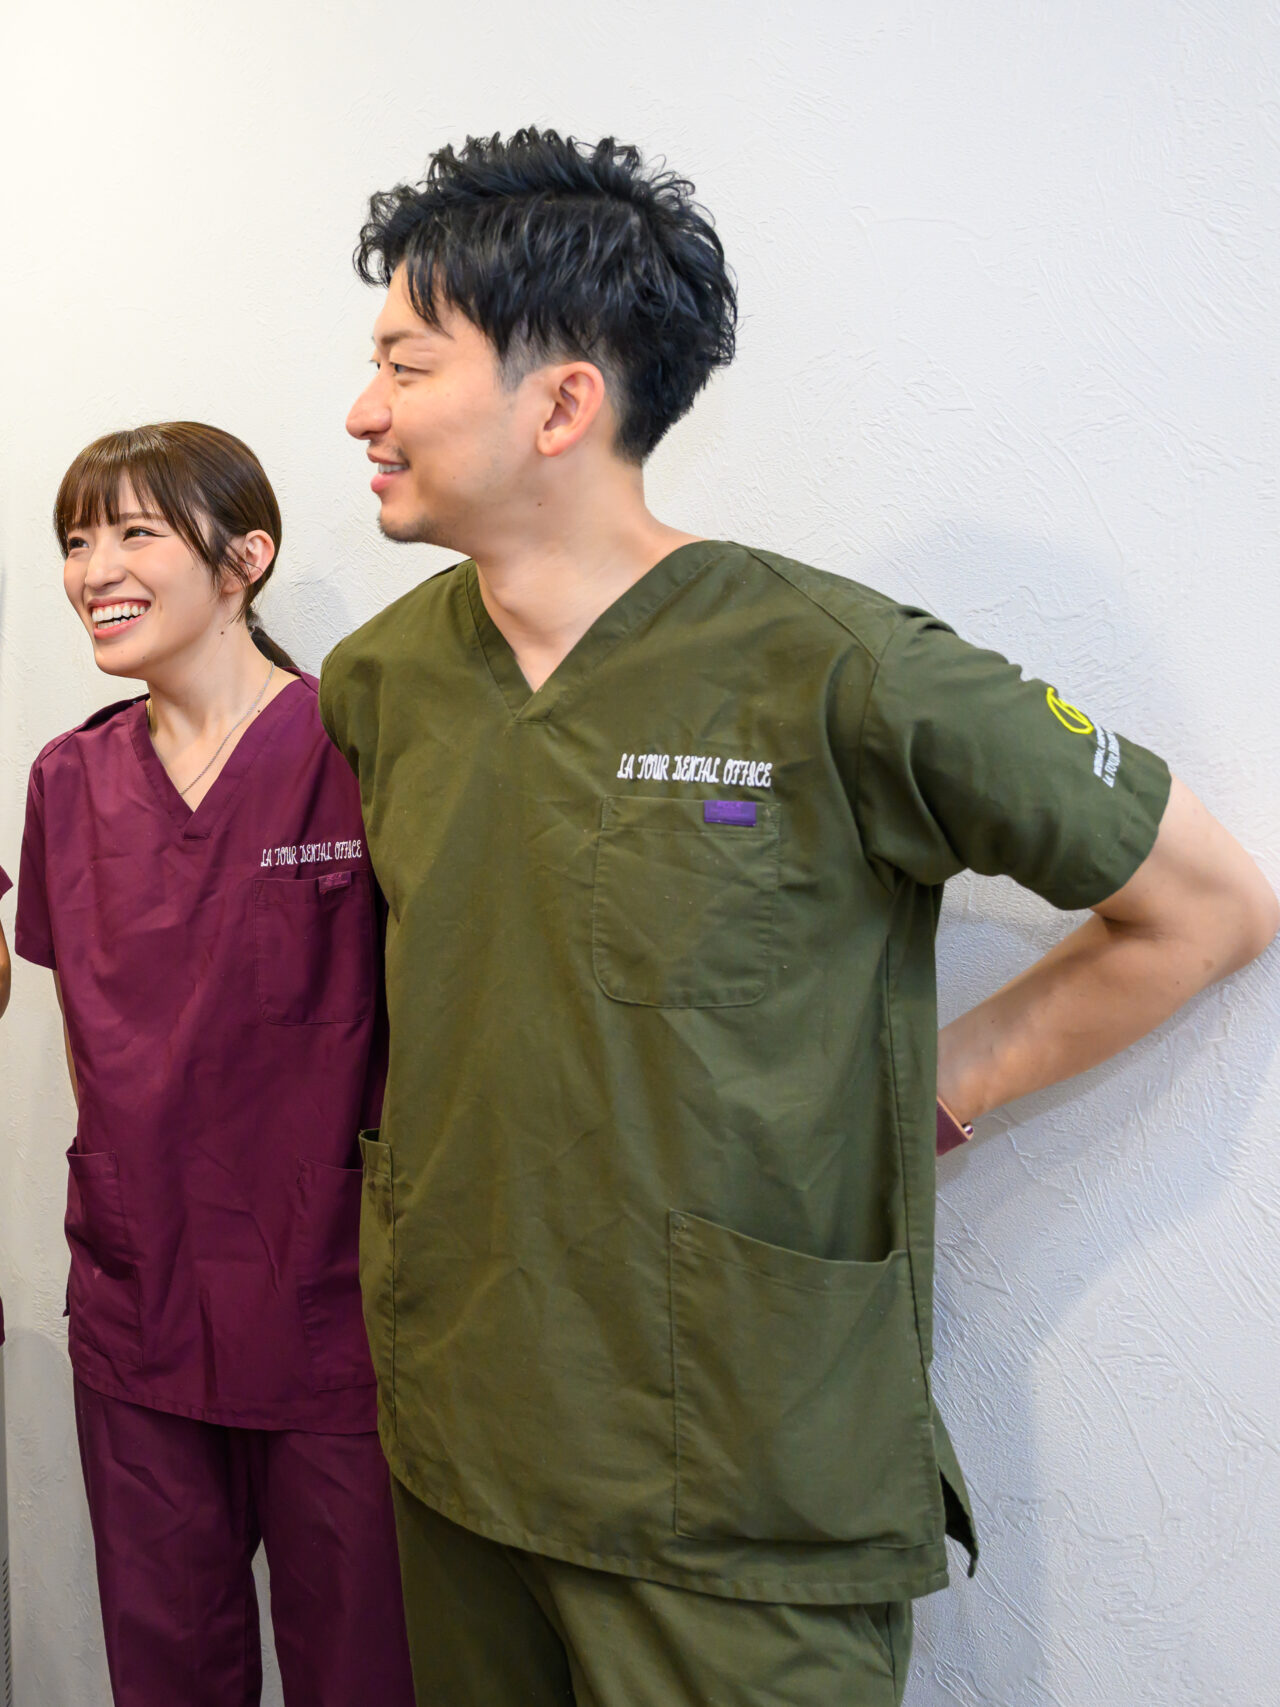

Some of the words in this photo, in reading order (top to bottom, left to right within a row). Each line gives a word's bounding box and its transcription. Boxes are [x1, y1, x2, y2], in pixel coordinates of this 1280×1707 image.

[617, 753, 635, 780] LA
[637, 754, 670, 781] TOUR
[672, 755, 721, 784] DENTAL
[722, 758, 773, 788] OFFICE
[261, 848, 272, 867] LA
[274, 846, 298, 866] TOUR
[300, 842, 333, 864] DENTAL
[334, 839, 363, 860] OFFICE
